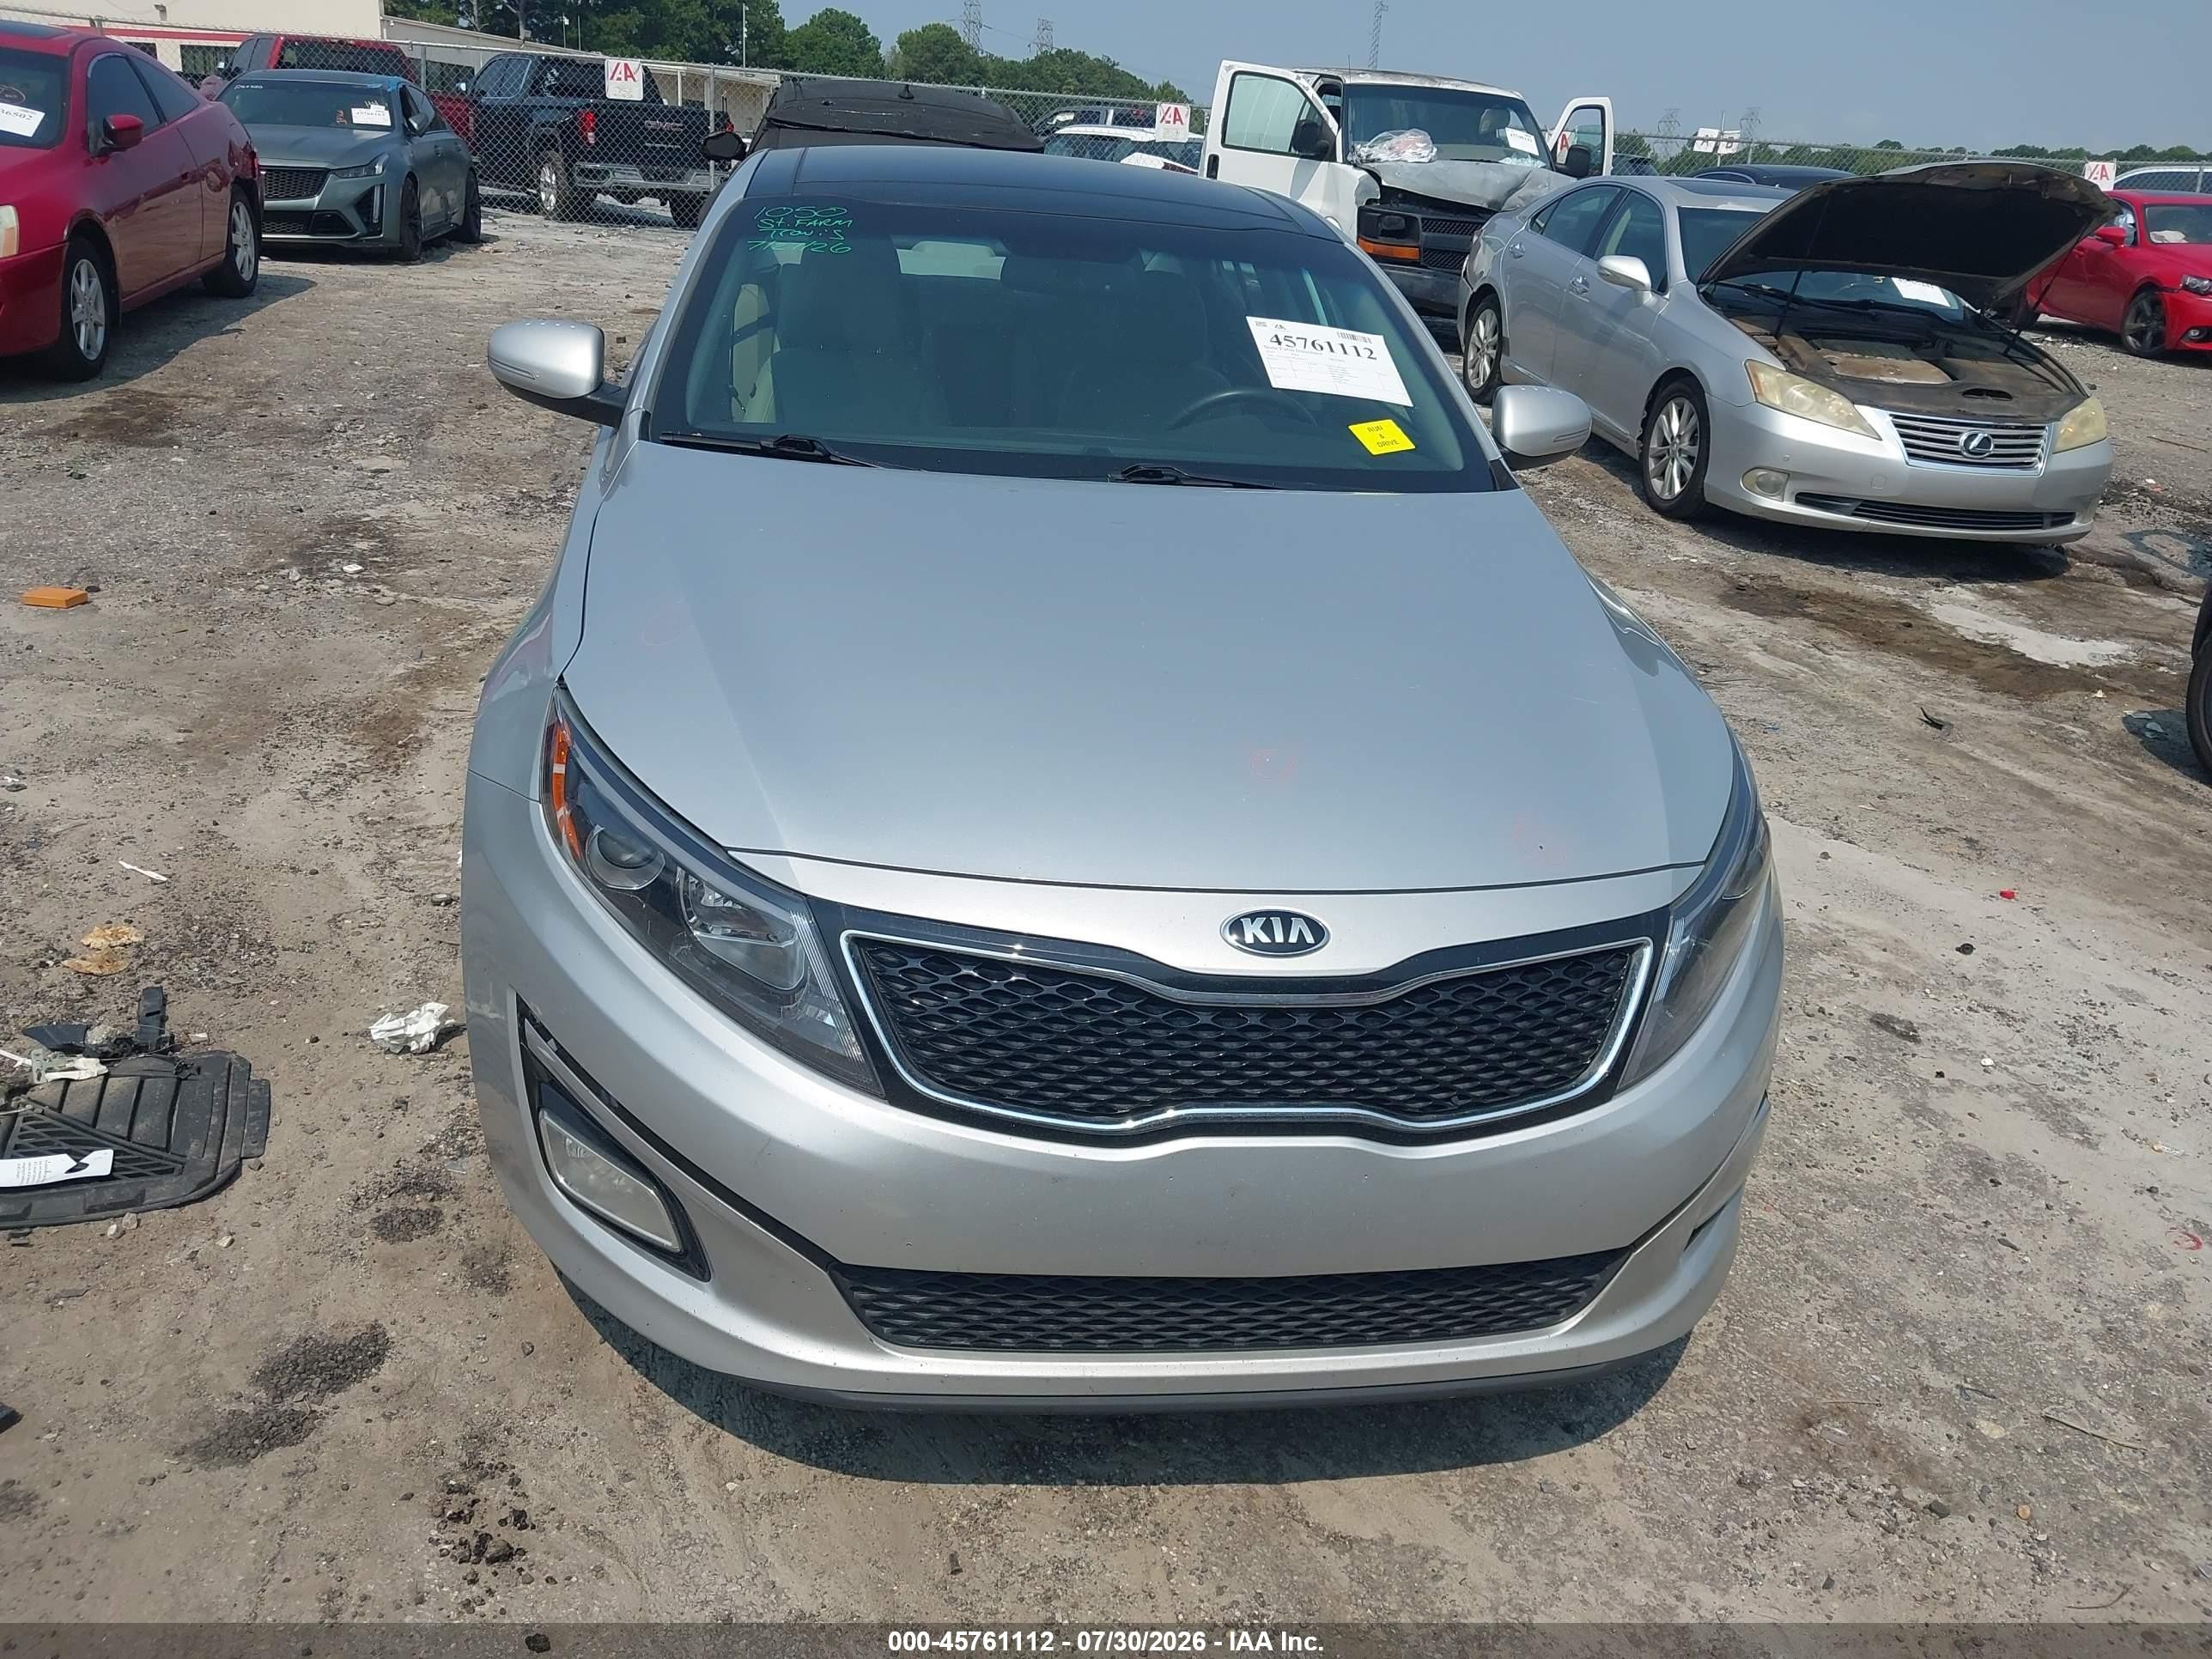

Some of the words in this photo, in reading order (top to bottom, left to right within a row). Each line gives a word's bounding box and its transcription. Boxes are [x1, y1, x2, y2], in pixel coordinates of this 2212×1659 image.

[644, 120, 686, 132] GMC
[754, 206, 848, 219] 1050
[1269, 333, 1377, 361] 45761112
[1366, 424, 1384, 434] RUN
[1376, 439, 1401, 447] DRIVE
[1240, 916, 1316, 944] KIA
